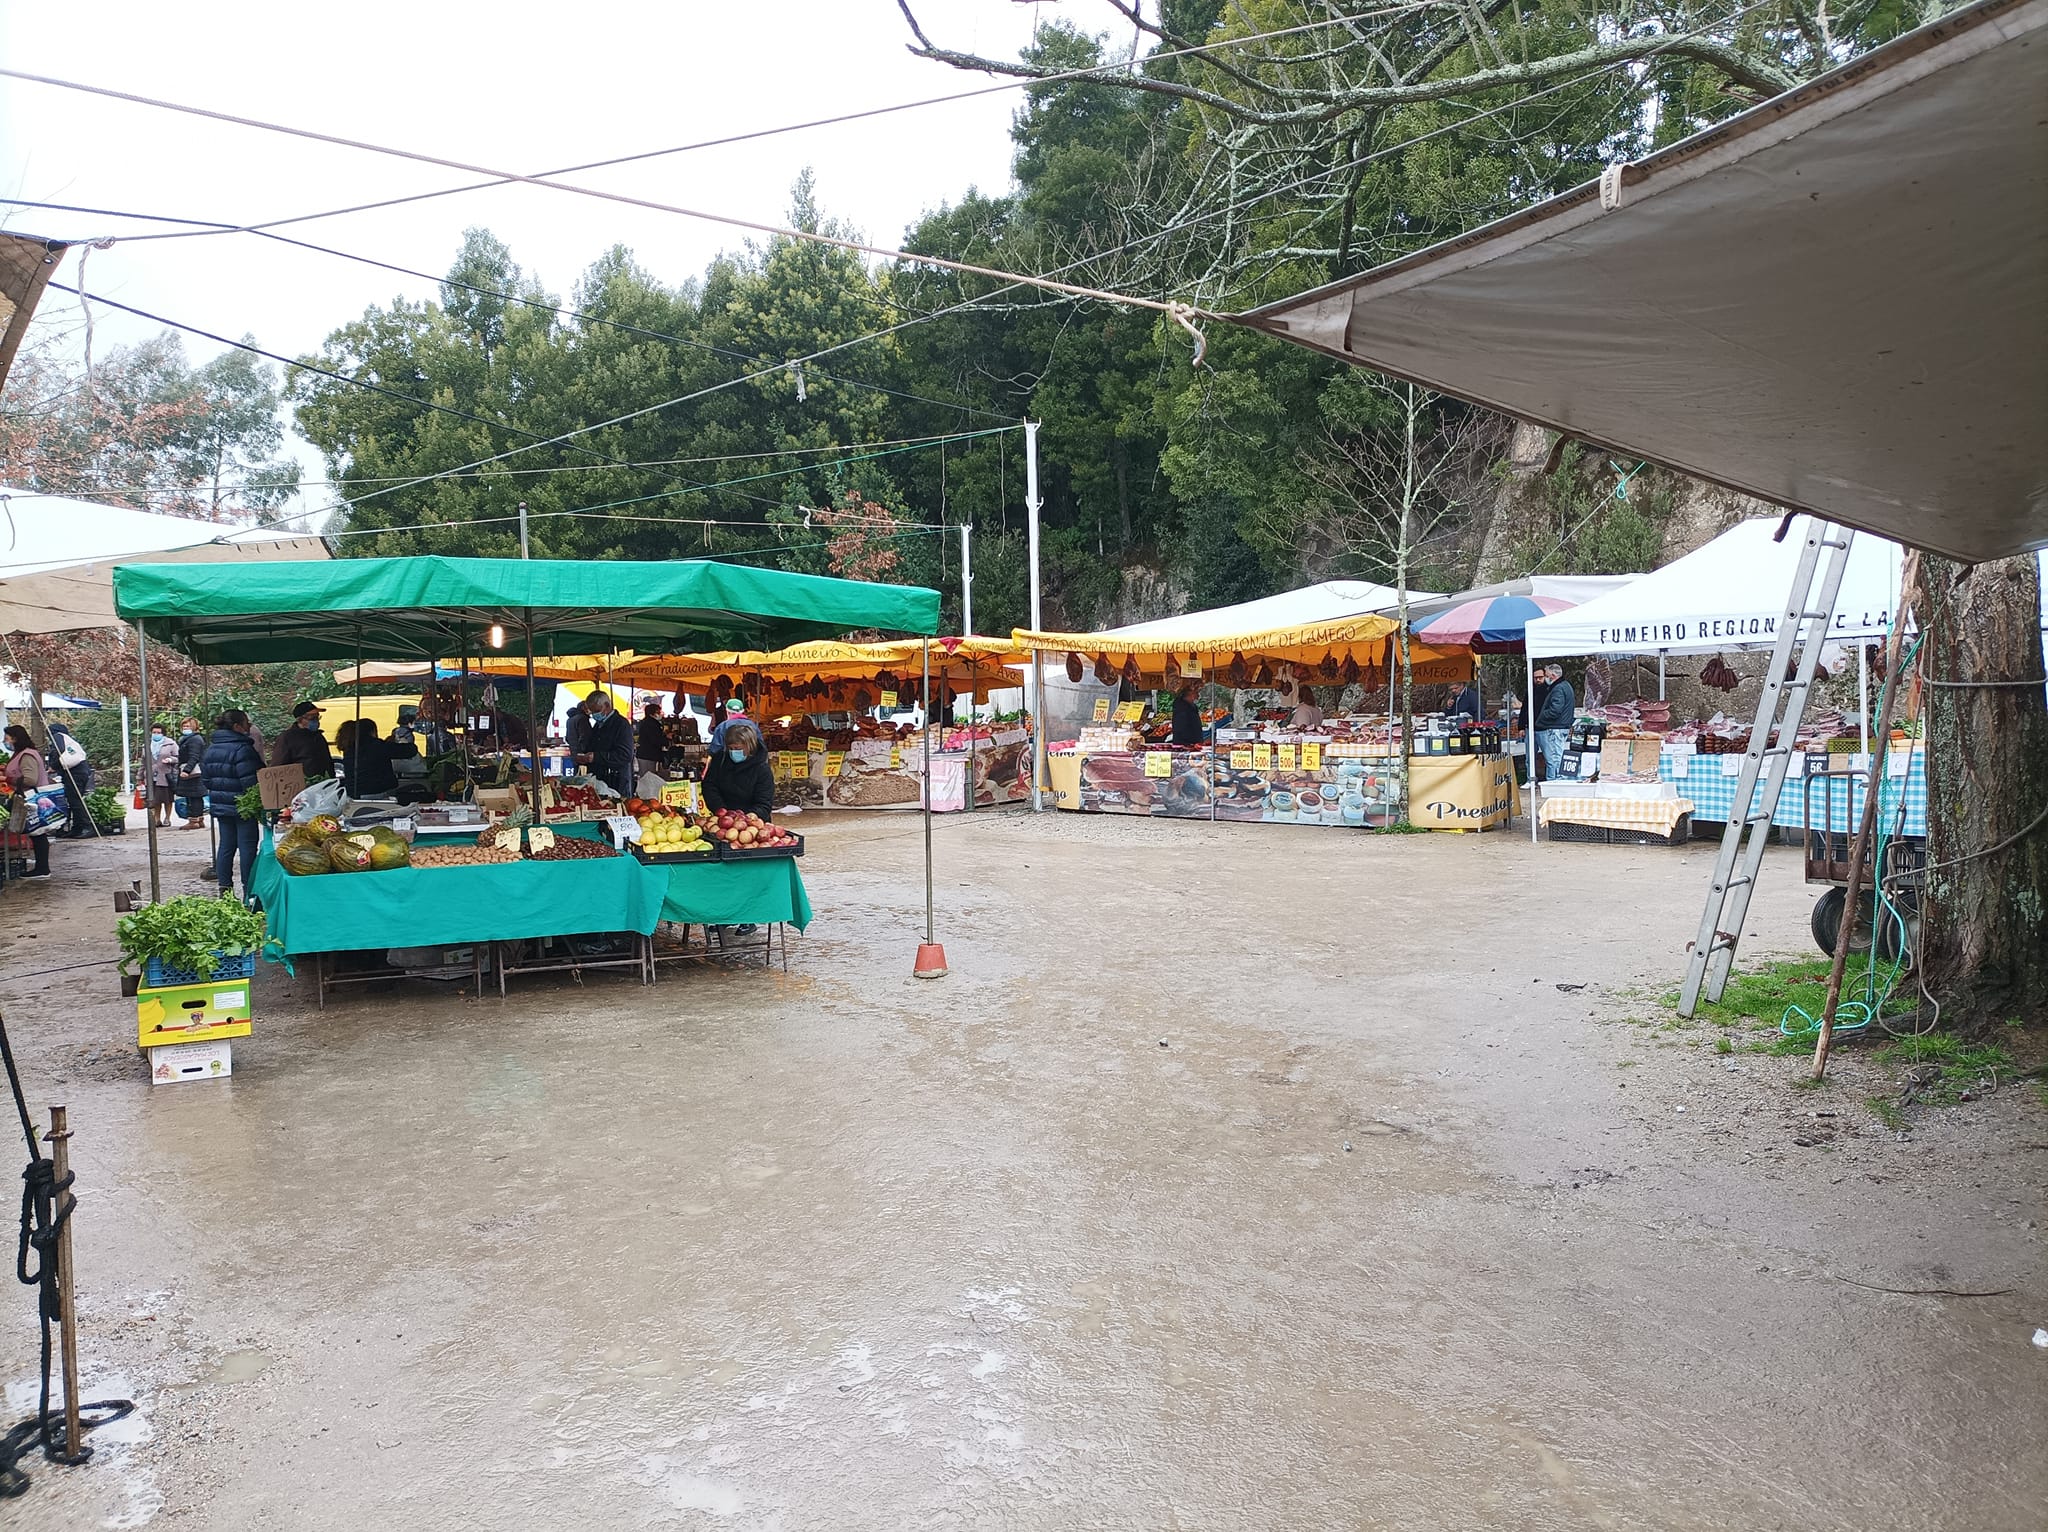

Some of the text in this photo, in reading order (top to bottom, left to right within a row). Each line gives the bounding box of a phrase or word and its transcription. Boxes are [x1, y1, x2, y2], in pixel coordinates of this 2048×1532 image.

[1208, 633, 1274, 652] REGIONAL
[1279, 632, 1295, 647] DE
[1300, 626, 1356, 645] LAMEGO
[1600, 623, 1686, 644] FUMEIRO
[1699, 617, 1803, 639] REGION
